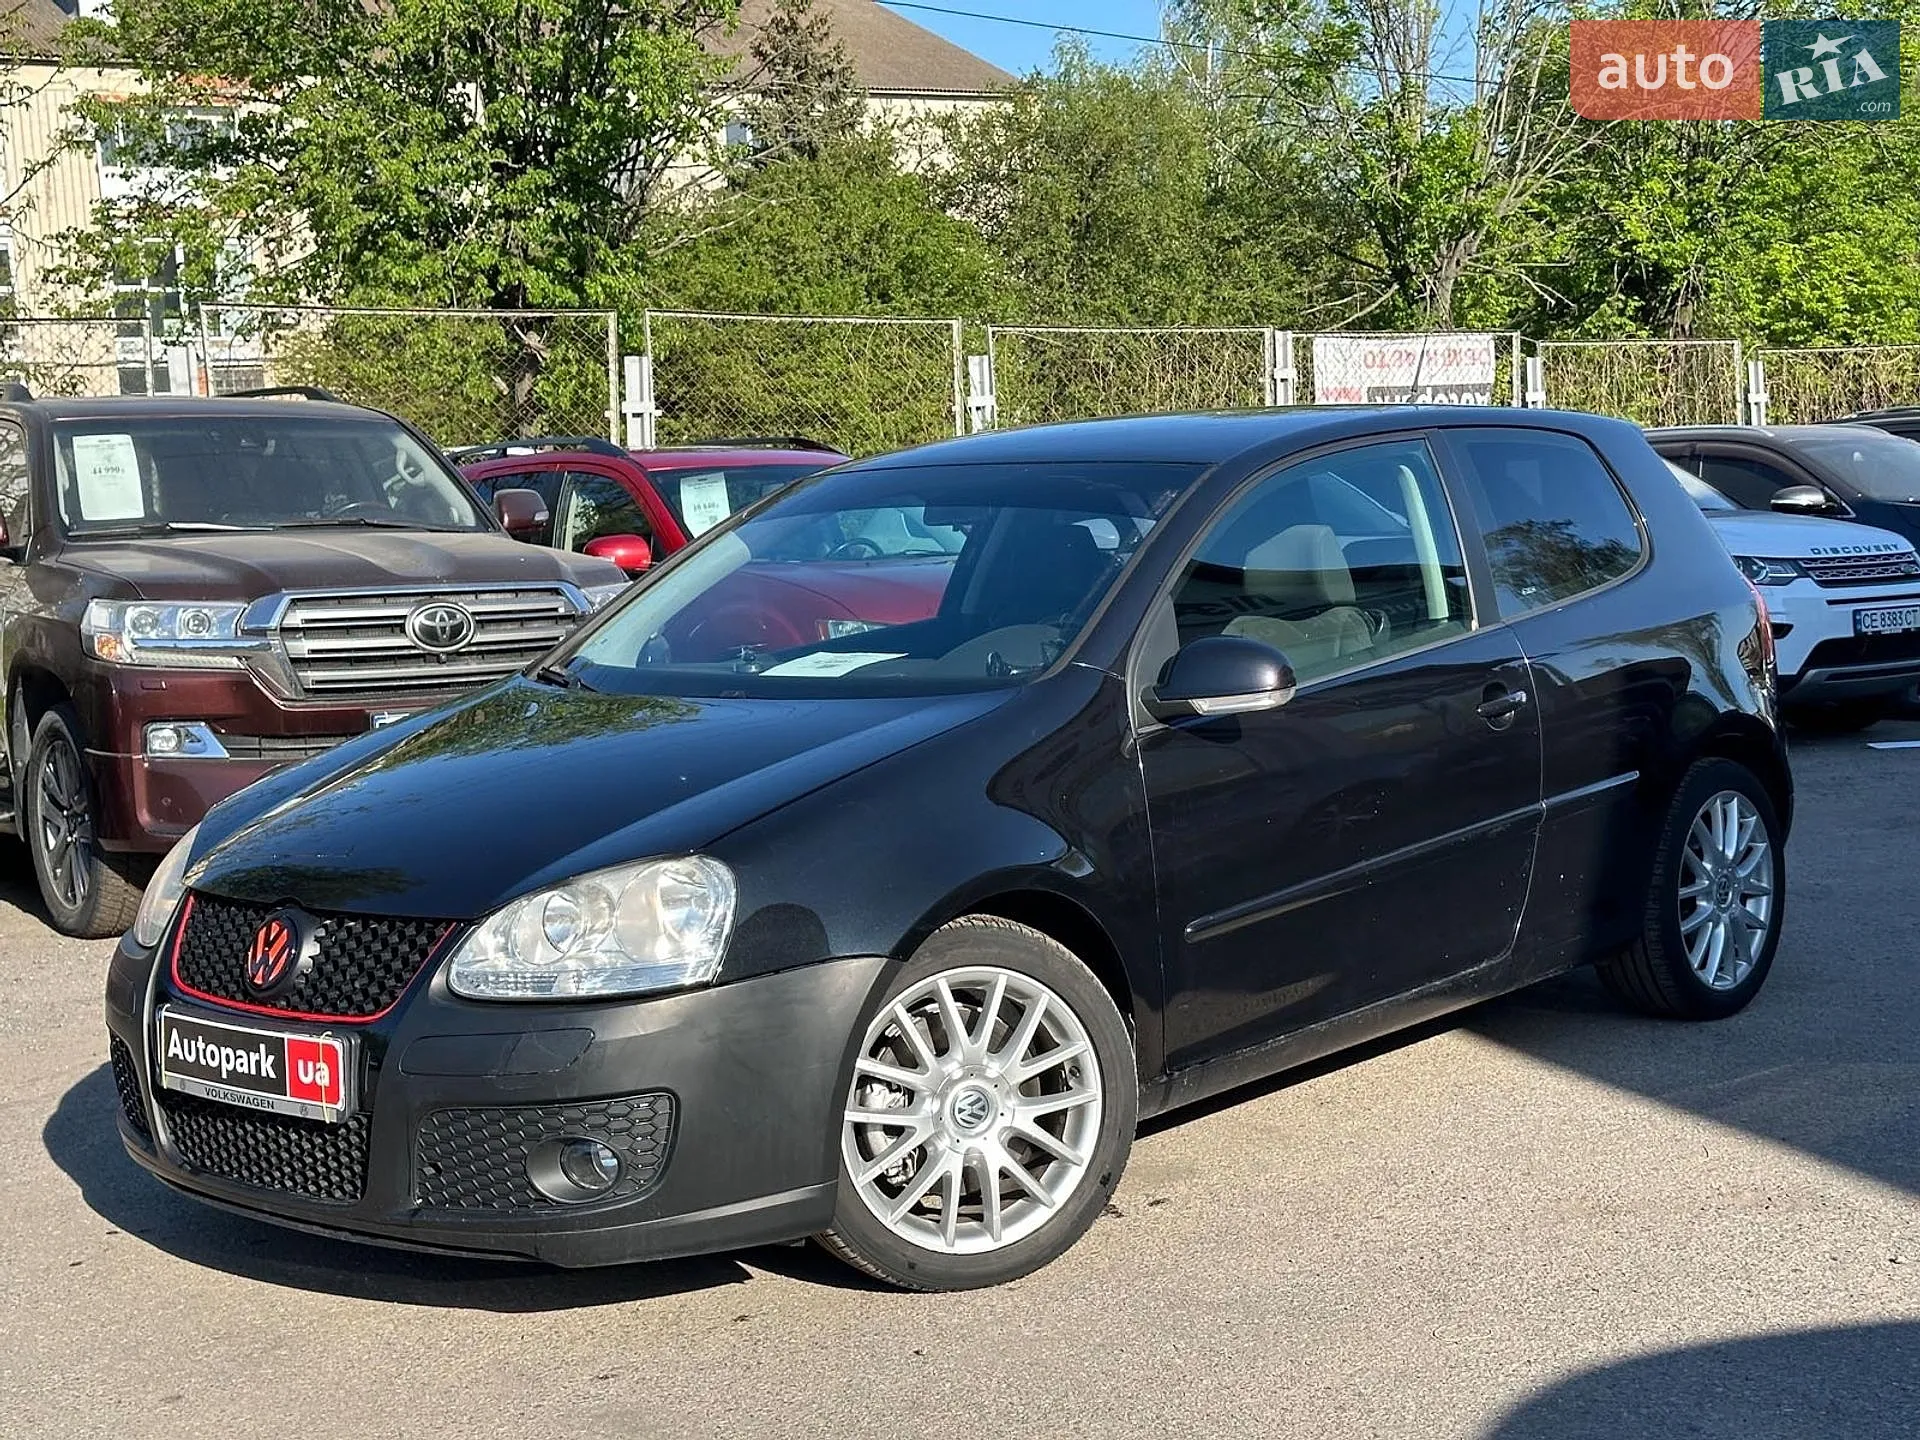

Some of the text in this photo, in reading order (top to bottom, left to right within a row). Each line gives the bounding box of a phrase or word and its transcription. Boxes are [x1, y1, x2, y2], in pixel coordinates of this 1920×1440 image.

[1810, 543, 1899, 555] DISCOVERY
[1880, 610, 1903, 628] 8383
[167, 1027, 277, 1080] Autopark
[204, 1086, 275, 1111] VOLKSWAGEN
